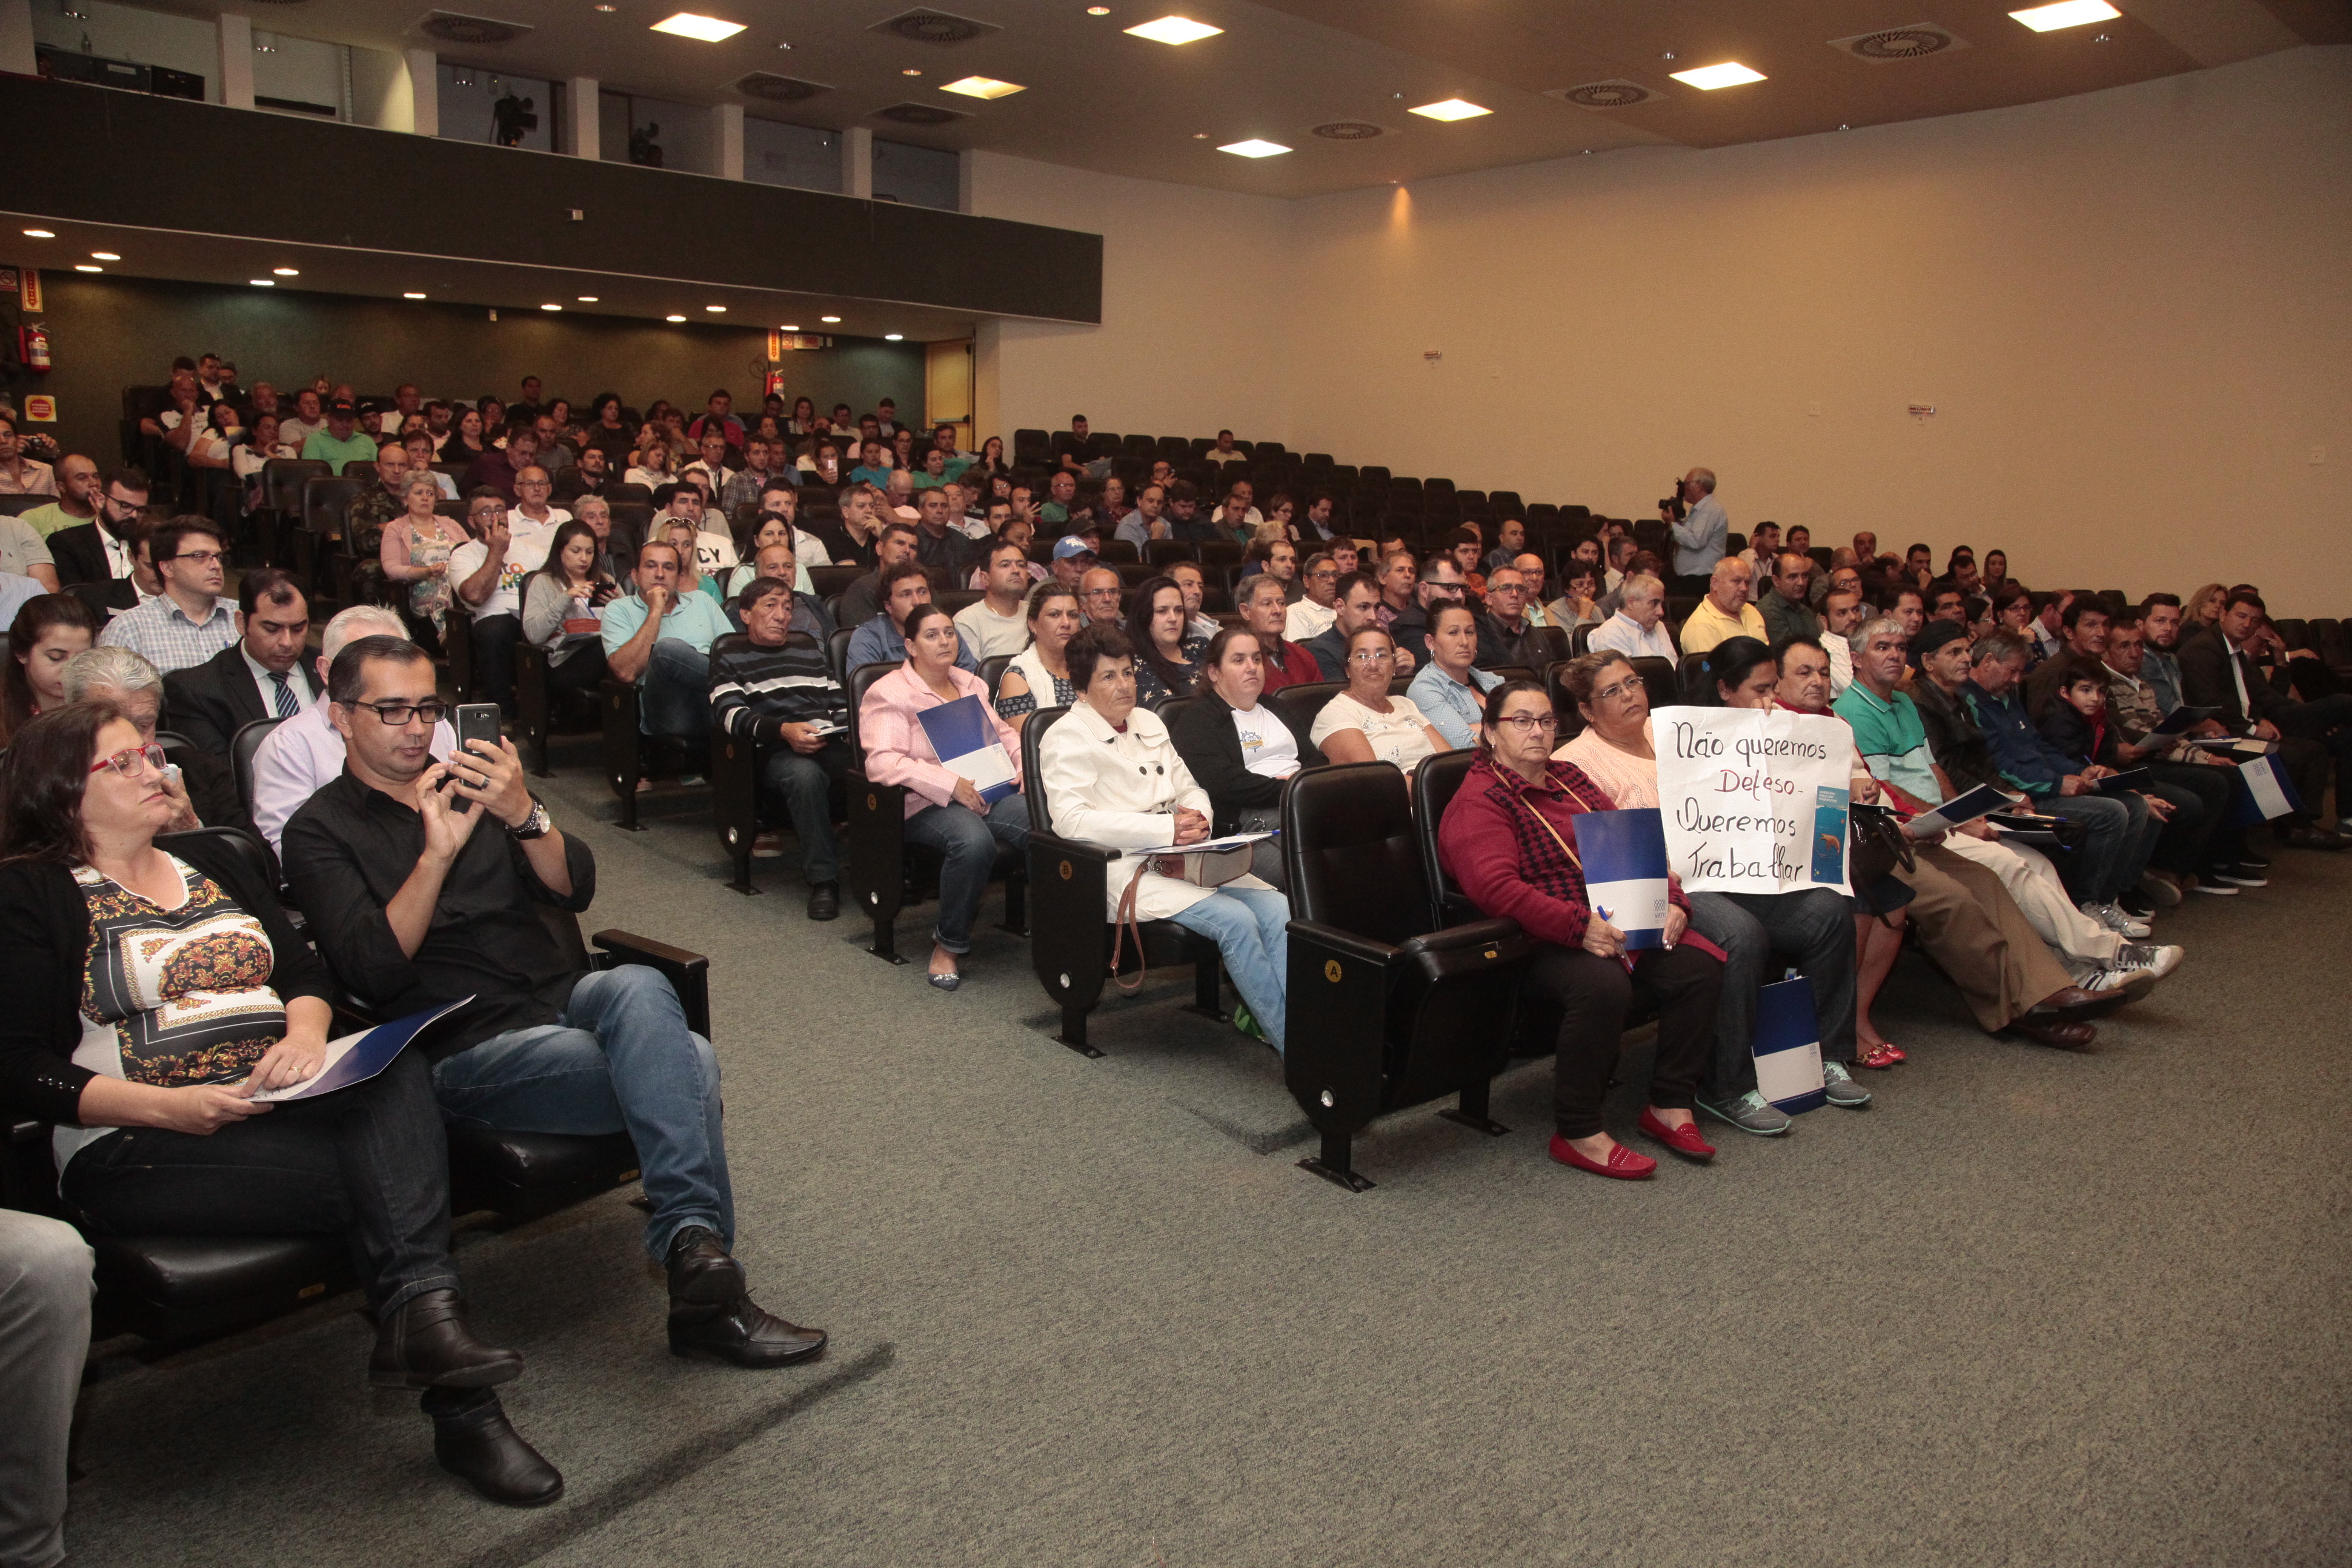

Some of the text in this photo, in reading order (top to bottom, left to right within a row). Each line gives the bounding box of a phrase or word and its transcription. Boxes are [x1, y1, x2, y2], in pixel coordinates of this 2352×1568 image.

[697, 548, 720, 564] CY
[499, 563, 526, 575] ta
[1671, 722, 1827, 767] Não queremos
[1676, 797, 1796, 836] Queremos
[1063, 865, 1069, 874] B
[1687, 841, 1803, 882] Trabalhar
[1330, 966, 1338, 978] A
